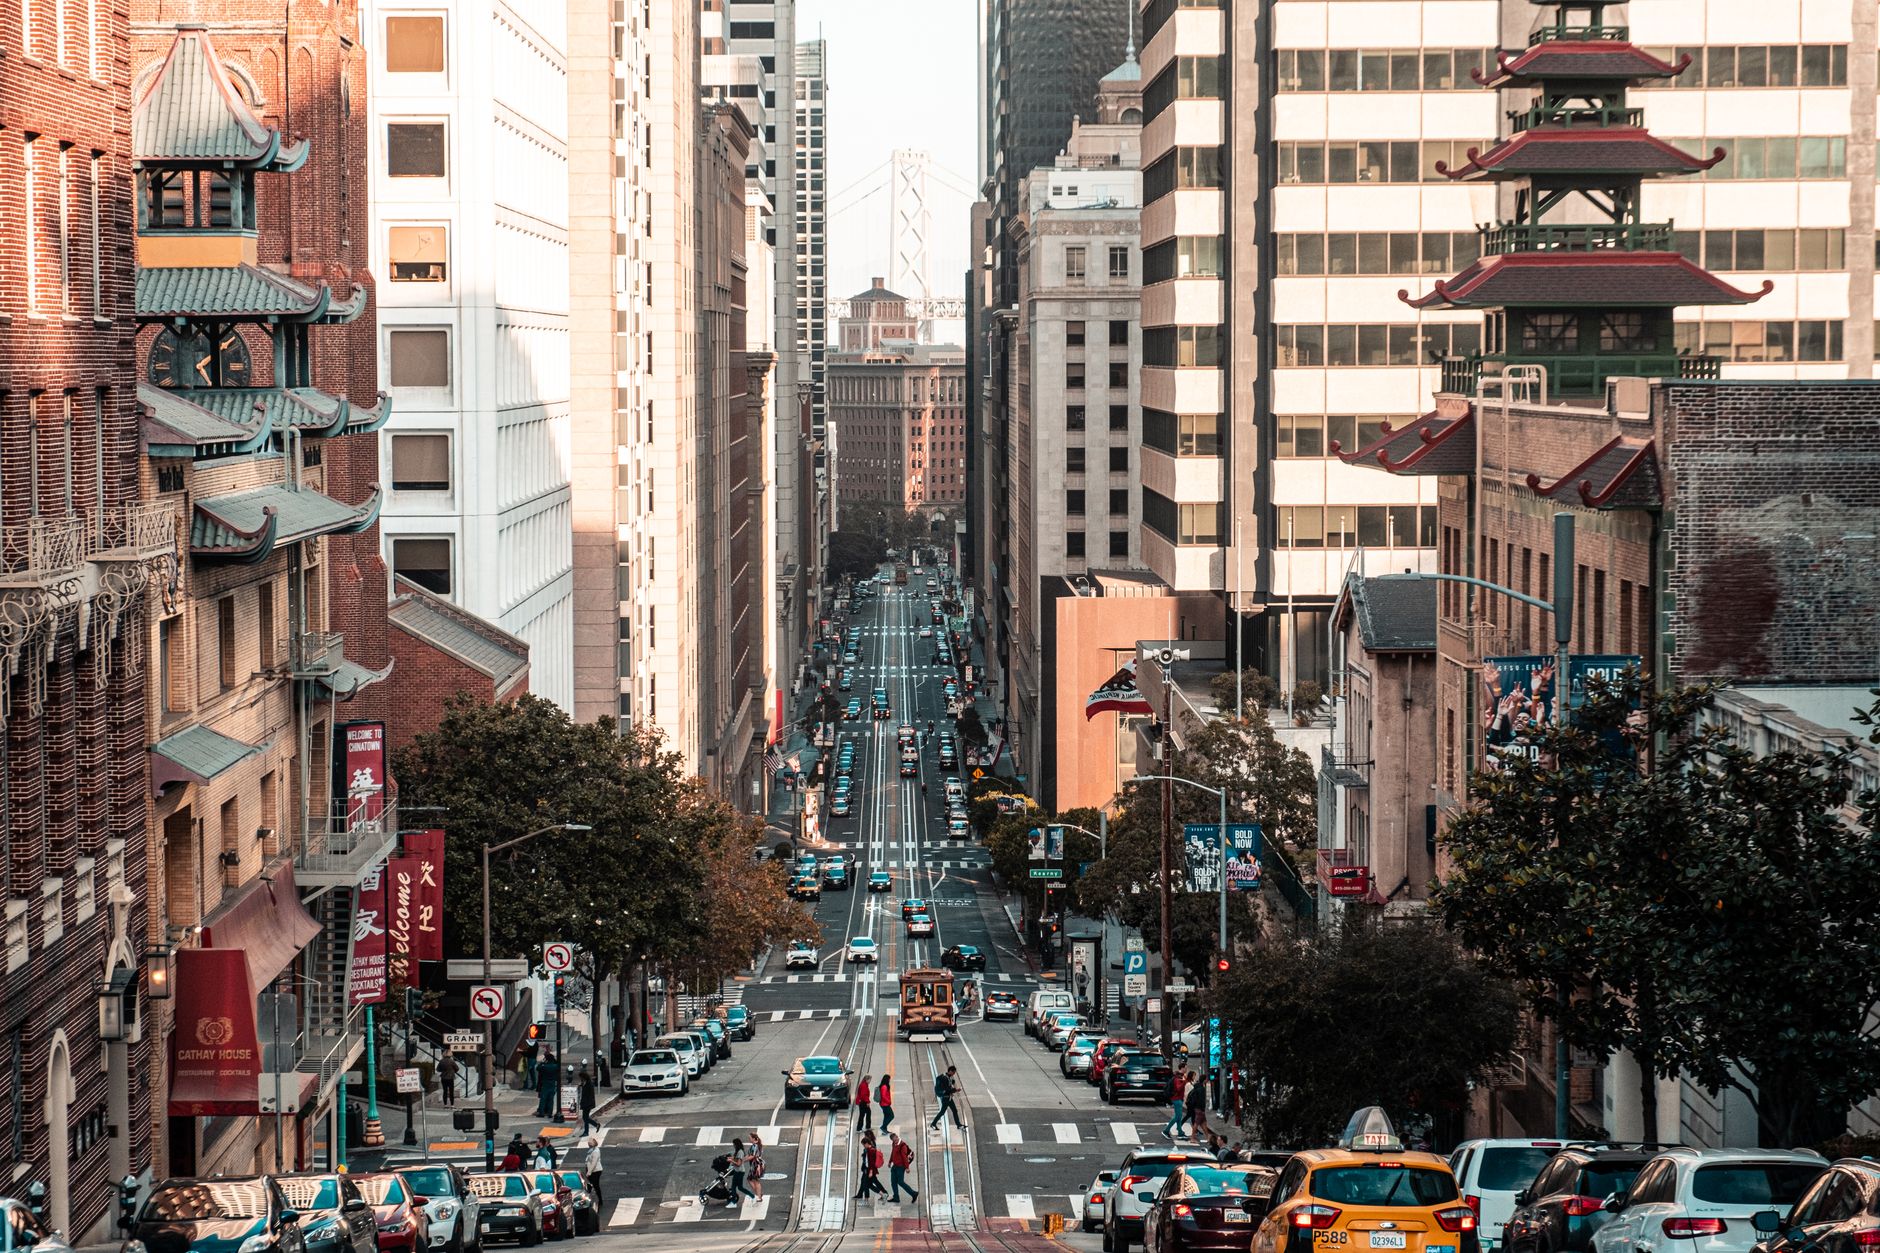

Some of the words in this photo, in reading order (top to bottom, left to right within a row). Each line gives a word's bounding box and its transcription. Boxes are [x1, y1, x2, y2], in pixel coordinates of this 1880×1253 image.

[347, 730, 372, 740] WELCOME
[375, 729, 382, 738] TO
[349, 741, 380, 752] CHINATOWN
[1235, 830, 1253, 839] BOLD
[1235, 839, 1252, 849] NOW
[1194, 867, 1212, 877] BOLD
[1195, 876, 1212, 885] THEN
[353, 956, 369, 967] ATHAY
[369, 955, 385, 965] HOUSE
[350, 966, 385, 979] RESTAURANT
[350, 979, 379, 991] COCKTAILS
[178, 1050, 215, 1060] CATHAY
[219, 1049, 251, 1060] HOUSE
[219, 1069, 251, 1077] COCKTAILS
[1365, 1135, 1387, 1144] TAXI
[1313, 1230, 1347, 1244] P588
